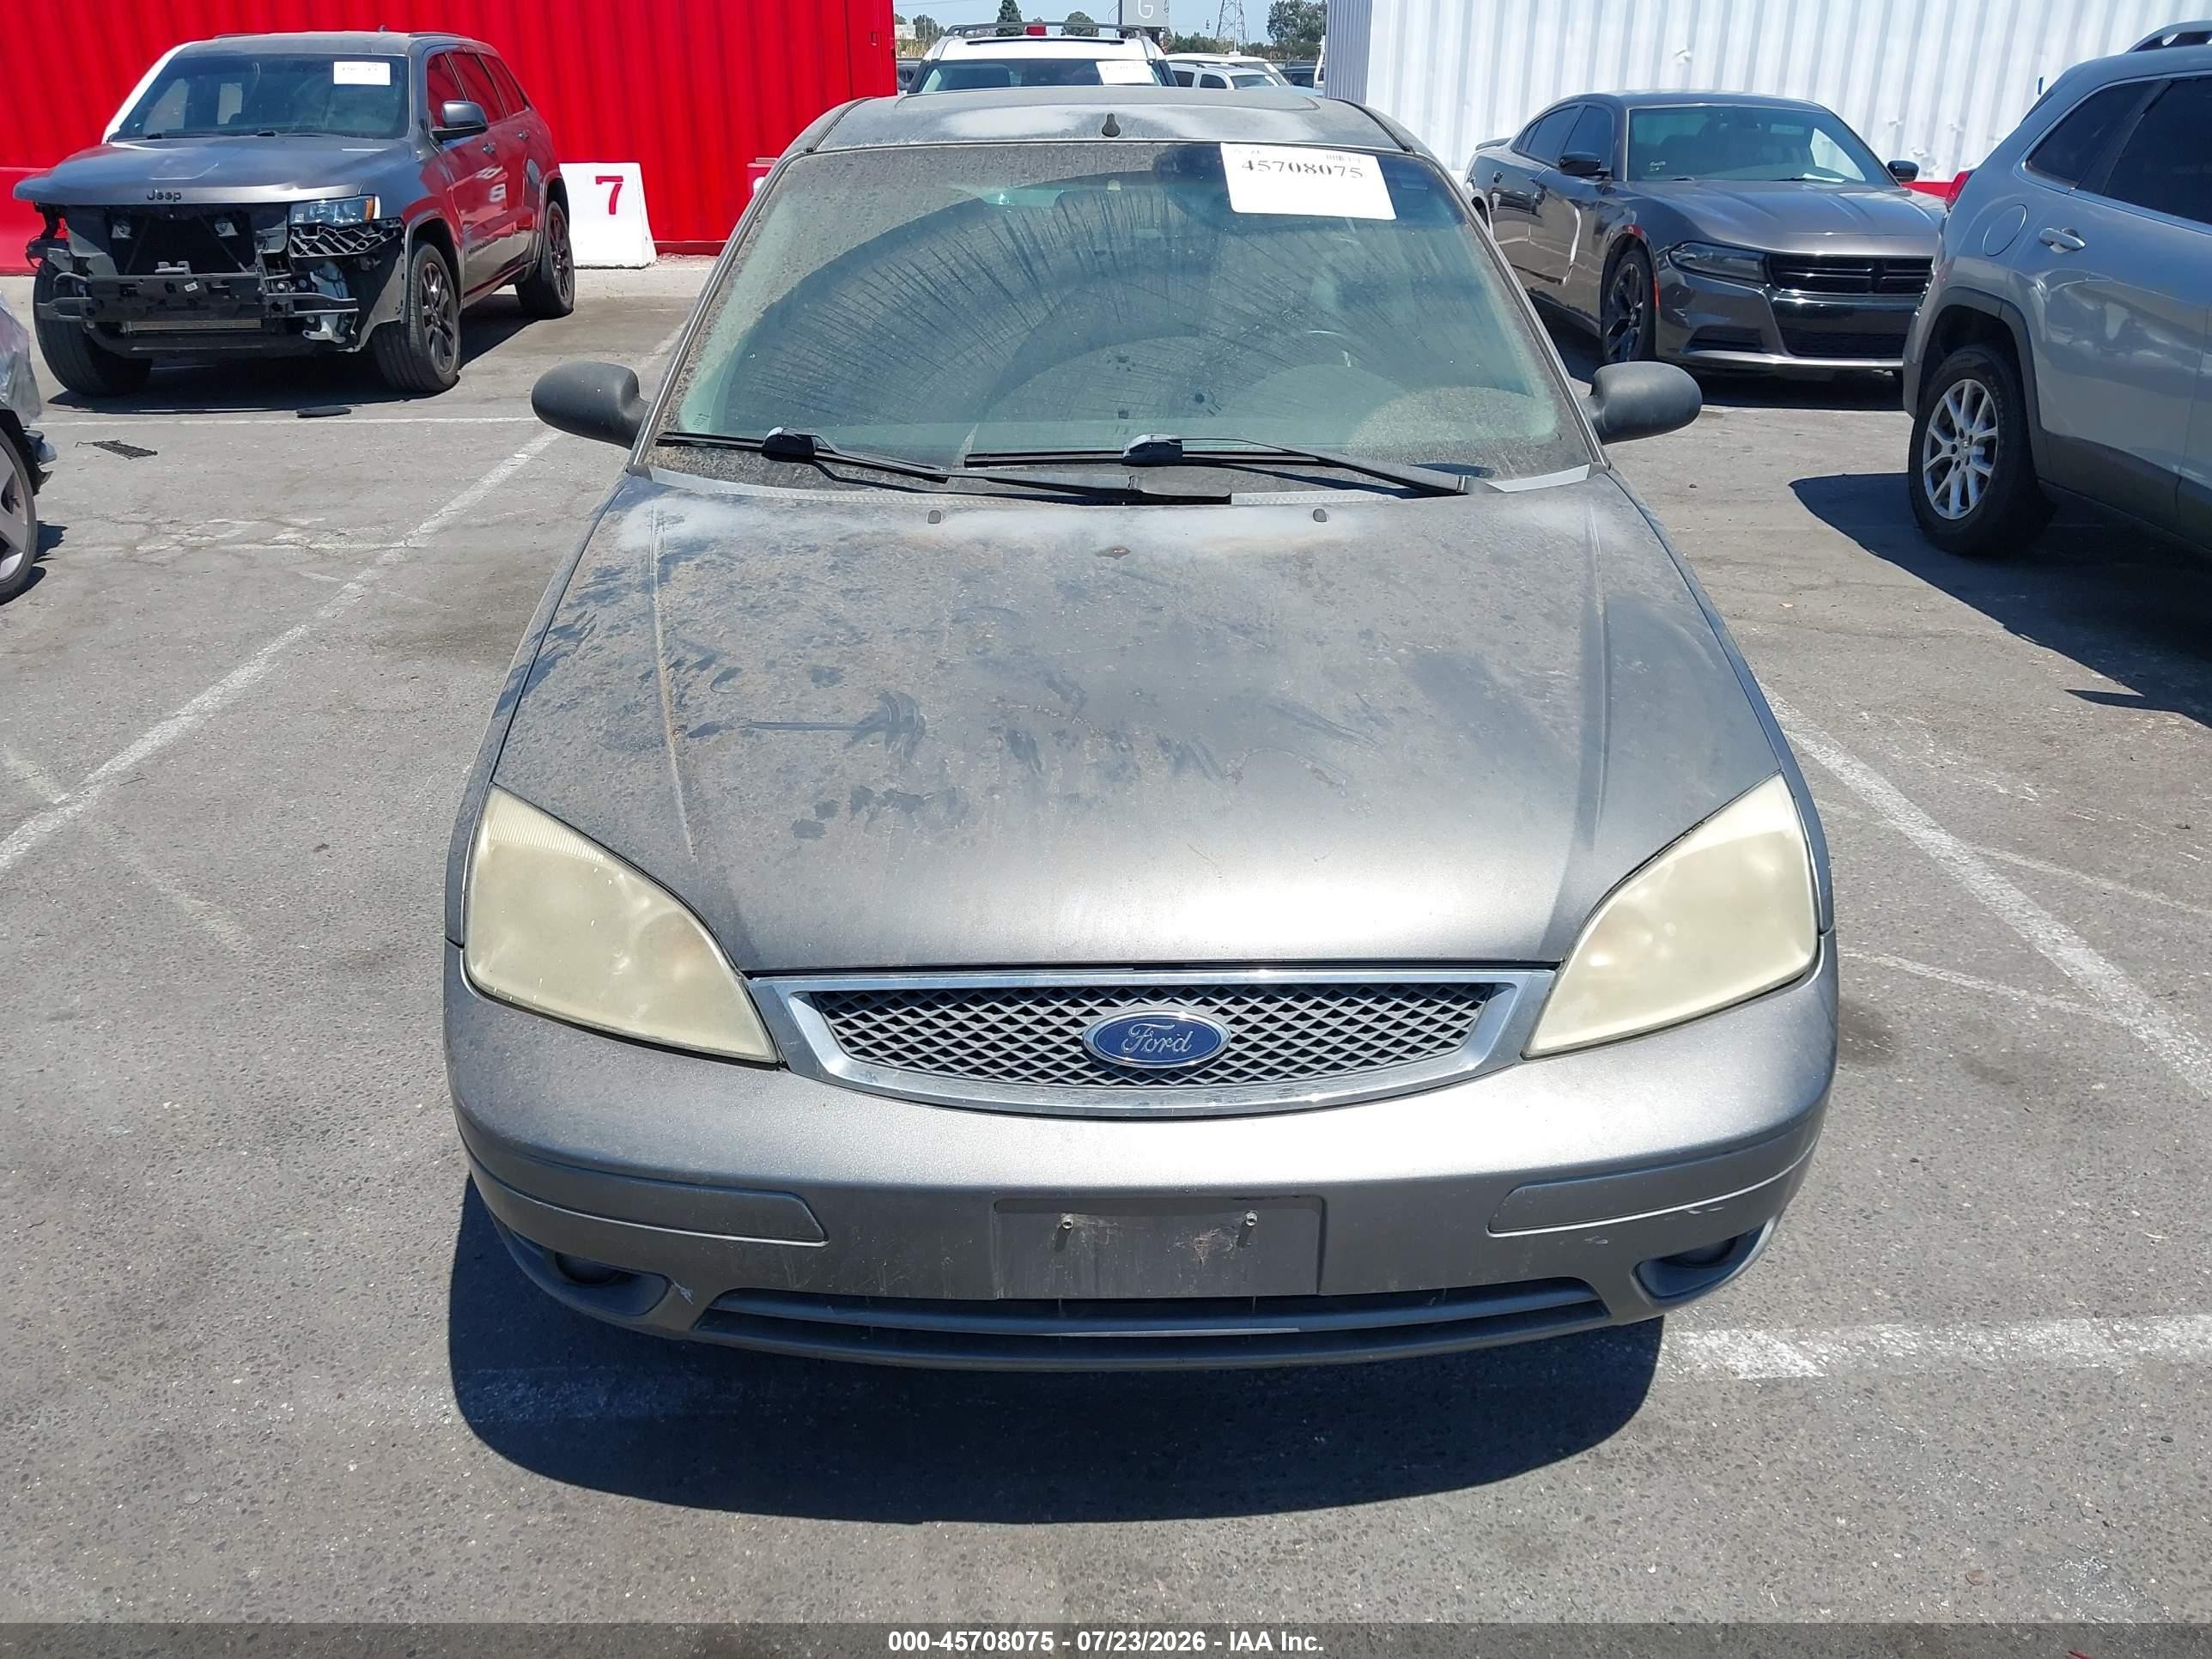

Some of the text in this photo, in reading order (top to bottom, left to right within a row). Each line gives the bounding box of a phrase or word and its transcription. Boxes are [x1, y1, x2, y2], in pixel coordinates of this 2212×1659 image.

[1138, 0, 1154, 19] G
[1242, 160, 1364, 179] 45708075
[146, 188, 182, 203] Jeep
[595, 175, 624, 215] 7
[1121, 1023, 1194, 1054] Ford
